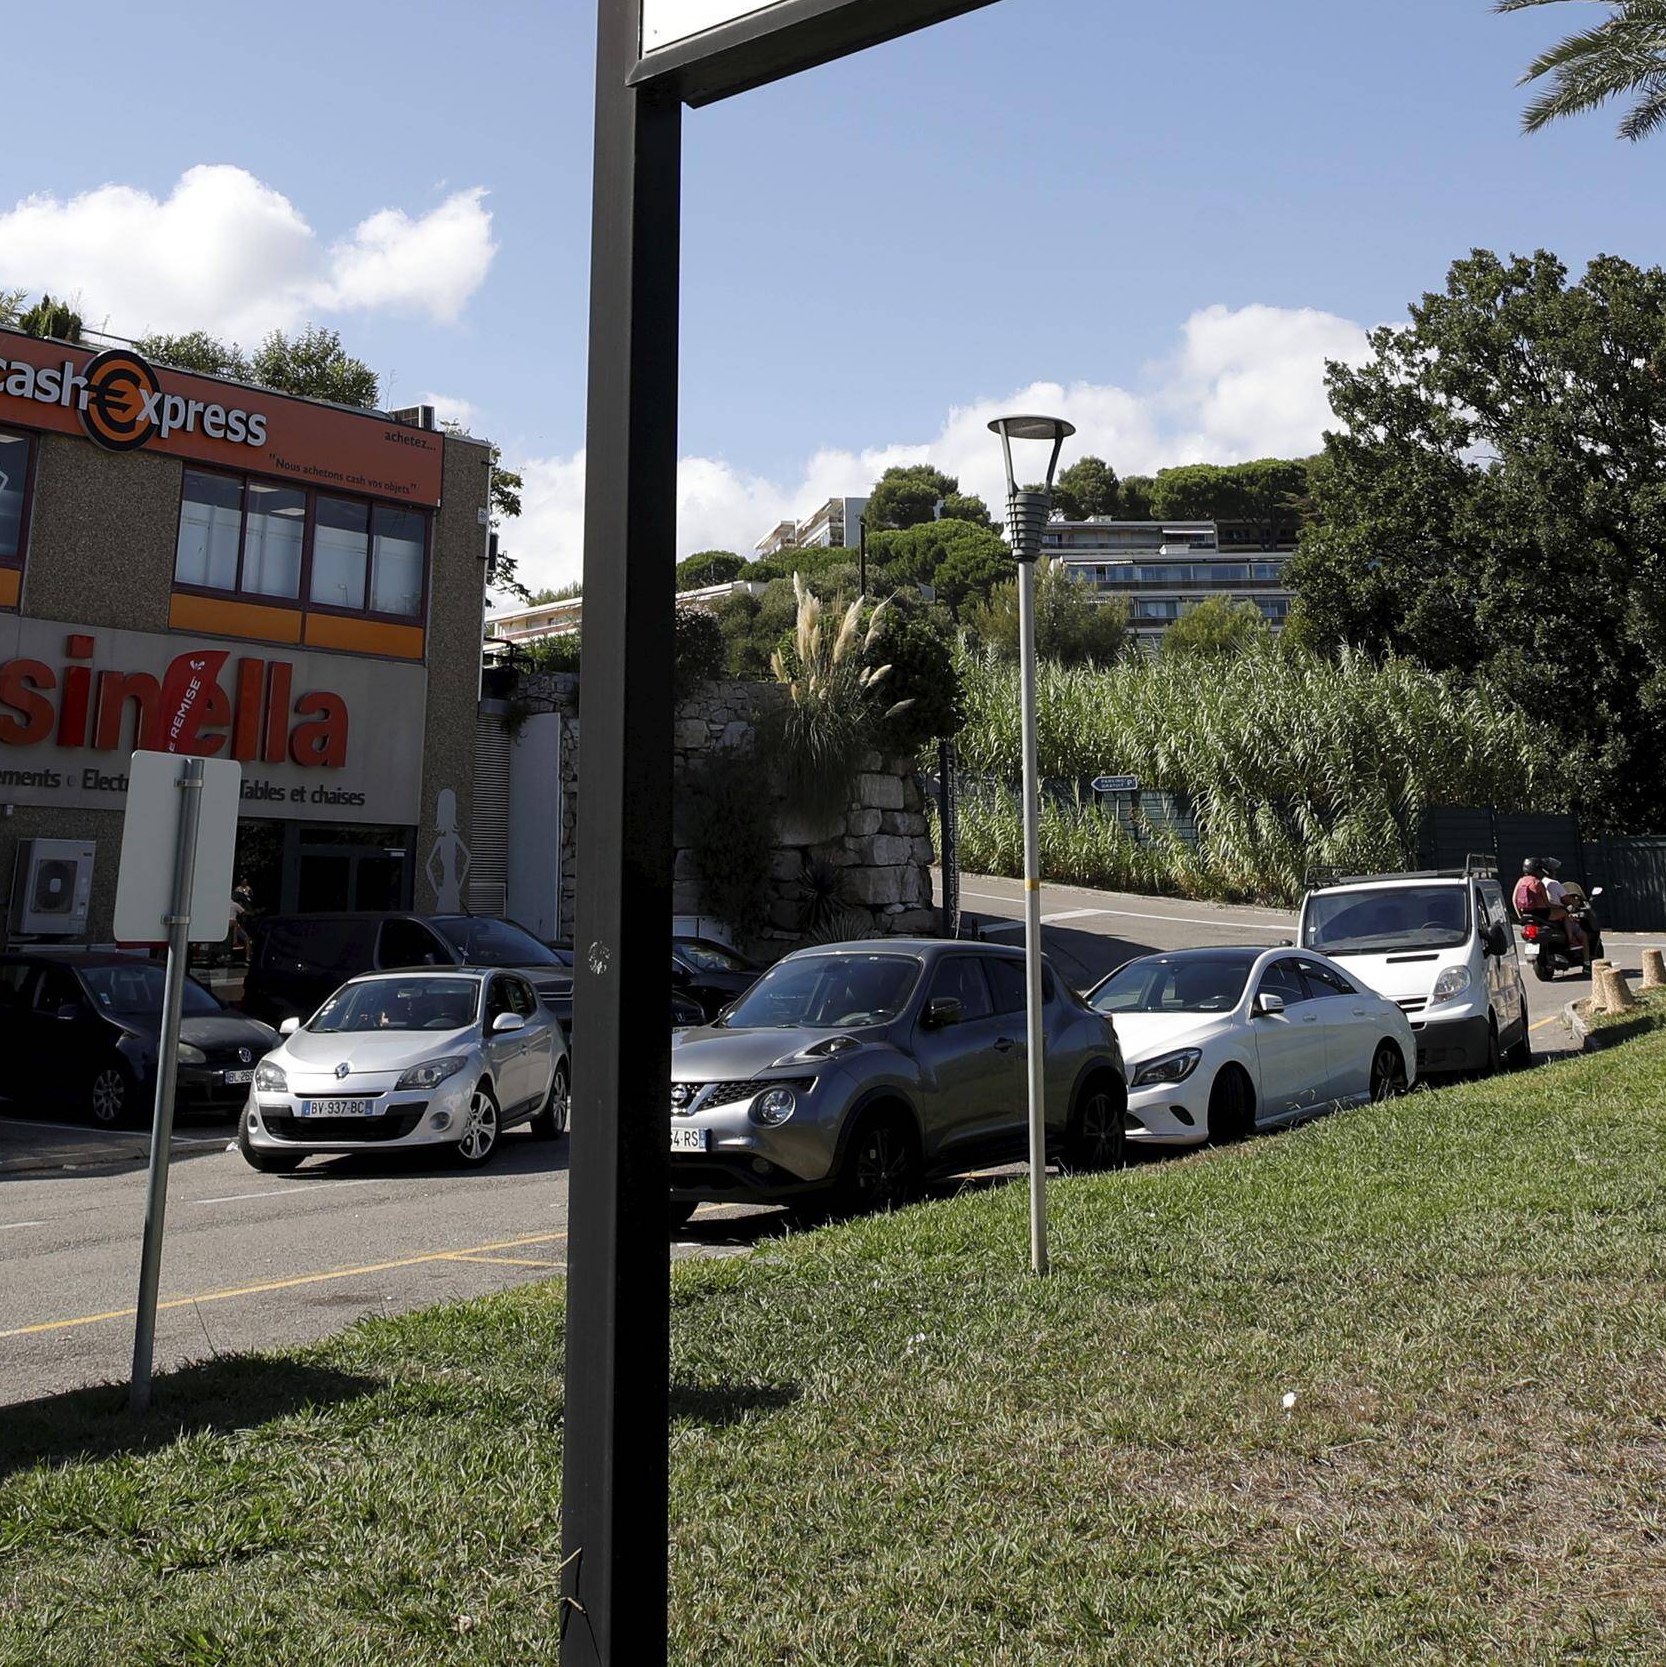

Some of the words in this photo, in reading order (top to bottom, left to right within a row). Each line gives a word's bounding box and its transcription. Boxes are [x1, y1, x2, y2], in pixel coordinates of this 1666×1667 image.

[303, 465, 344, 482] achetons
[346, 474, 366, 487] cash
[368, 479, 383, 490] vos
[170, 675, 201, 739] REMISE
[291, 786, 306, 803] et
[311, 785, 365, 806] chaises
